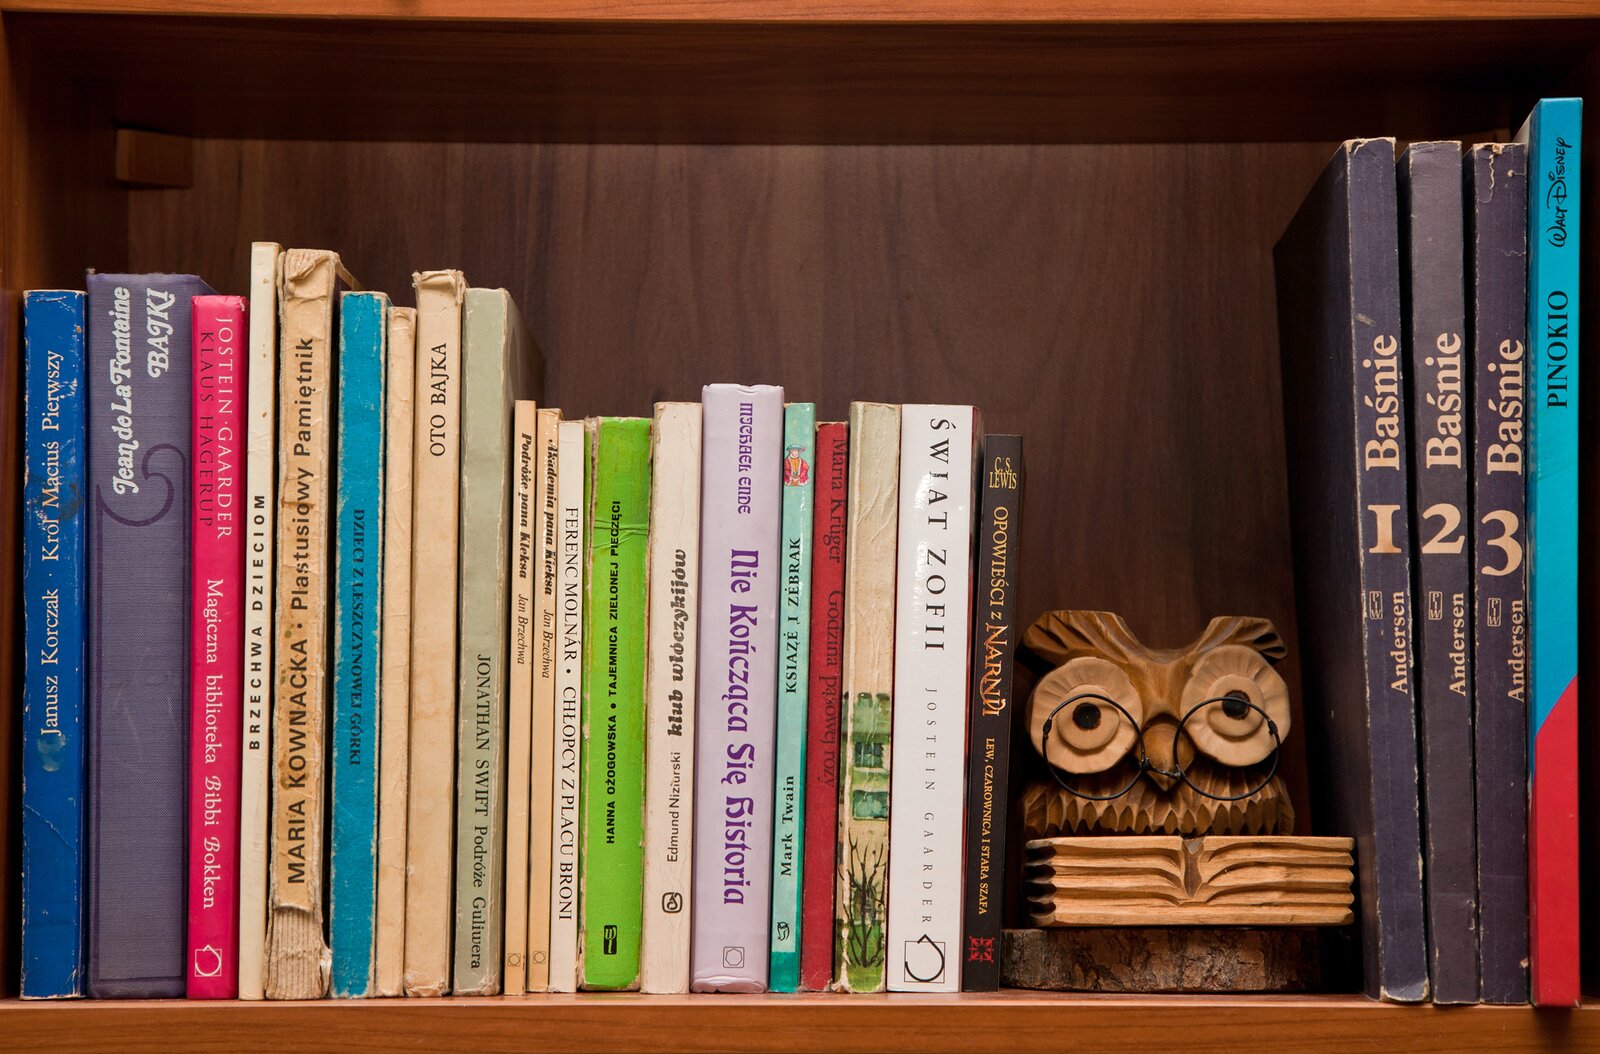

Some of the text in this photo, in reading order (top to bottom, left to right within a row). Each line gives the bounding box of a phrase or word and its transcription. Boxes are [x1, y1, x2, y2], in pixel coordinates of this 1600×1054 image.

[147, 288, 175, 379] BAJKI
[1547, 290, 1569, 409] PINOKIO
[108, 287, 139, 494] Jean de La Fontaine
[199, 331, 214, 527] KLAUS HAGERUP
[216, 317, 233, 539] JOSTEIN GAARDER
[430, 343, 449, 456] OTO BAJKA
[1363, 334, 1400, 471] Baśnie
[1425, 332, 1462, 469] Baśnie
[1487, 339, 1523, 475] Baśnie
[737, 478, 751, 514] ENDE
[823, 499, 845, 563] Krüger
[989, 470, 1017, 489] LEWIS
[1422, 503, 1465, 554] 2
[41, 351, 64, 736] Janusz Korczak Król Maciuś Pierwszy
[517, 433, 532, 665] Podróże pana Kleksa Jan Brzechwa
[542, 440, 558, 679] Akademia pana Kleksa Jan Brzechwa
[925, 418, 956, 651] ŚWIAT ZOFII
[990, 506, 1009, 606] OPOWIEŚCI
[1481, 509, 1523, 576] 3
[249, 494, 266, 751] BRZECHWA DZIECIOM
[287, 337, 315, 884] MARIA KOWNACKA Plastusiowy Pamiętnik
[349, 508, 365, 766] DZIECI Z LESZCZYNOWEJ GÓRKI
[788, 615, 801, 625] I
[827, 591, 843, 668] Godzina
[991, 611, 1002, 620] z
[1390, 591, 1408, 694] Andersen
[1449, 592, 1466, 696] Andersen
[1507, 599, 1524, 703] Andersen
[559, 507, 581, 921] FERENC MOLNÁR CHŁOPCY Z PLACU BRONI
[606, 500, 623, 844] HANNA OŻOGOWSKA TAJEMNICA ZIELONEJ PIECZĘCI
[668, 690, 684, 737] klub
[203, 578, 224, 910] Magiczna biblioteka Bibbi Bokken
[668, 751, 681, 808] Niziurski
[720, 549, 759, 905] Nie Kończąca Się Historia
[984, 738, 995, 763] LEW,
[470, 654, 491, 970] JONATHAN SWIFT Podróże Guliwera
[667, 810, 678, 863] Edmund
[781, 775, 794, 877] Mark Twain
[922, 688, 937, 923] JOSTEIN GAARDER
[982, 766, 993, 836] CZAROWNICA
[978, 883, 989, 915] SZAFA
[980, 845, 991, 880] STARA
